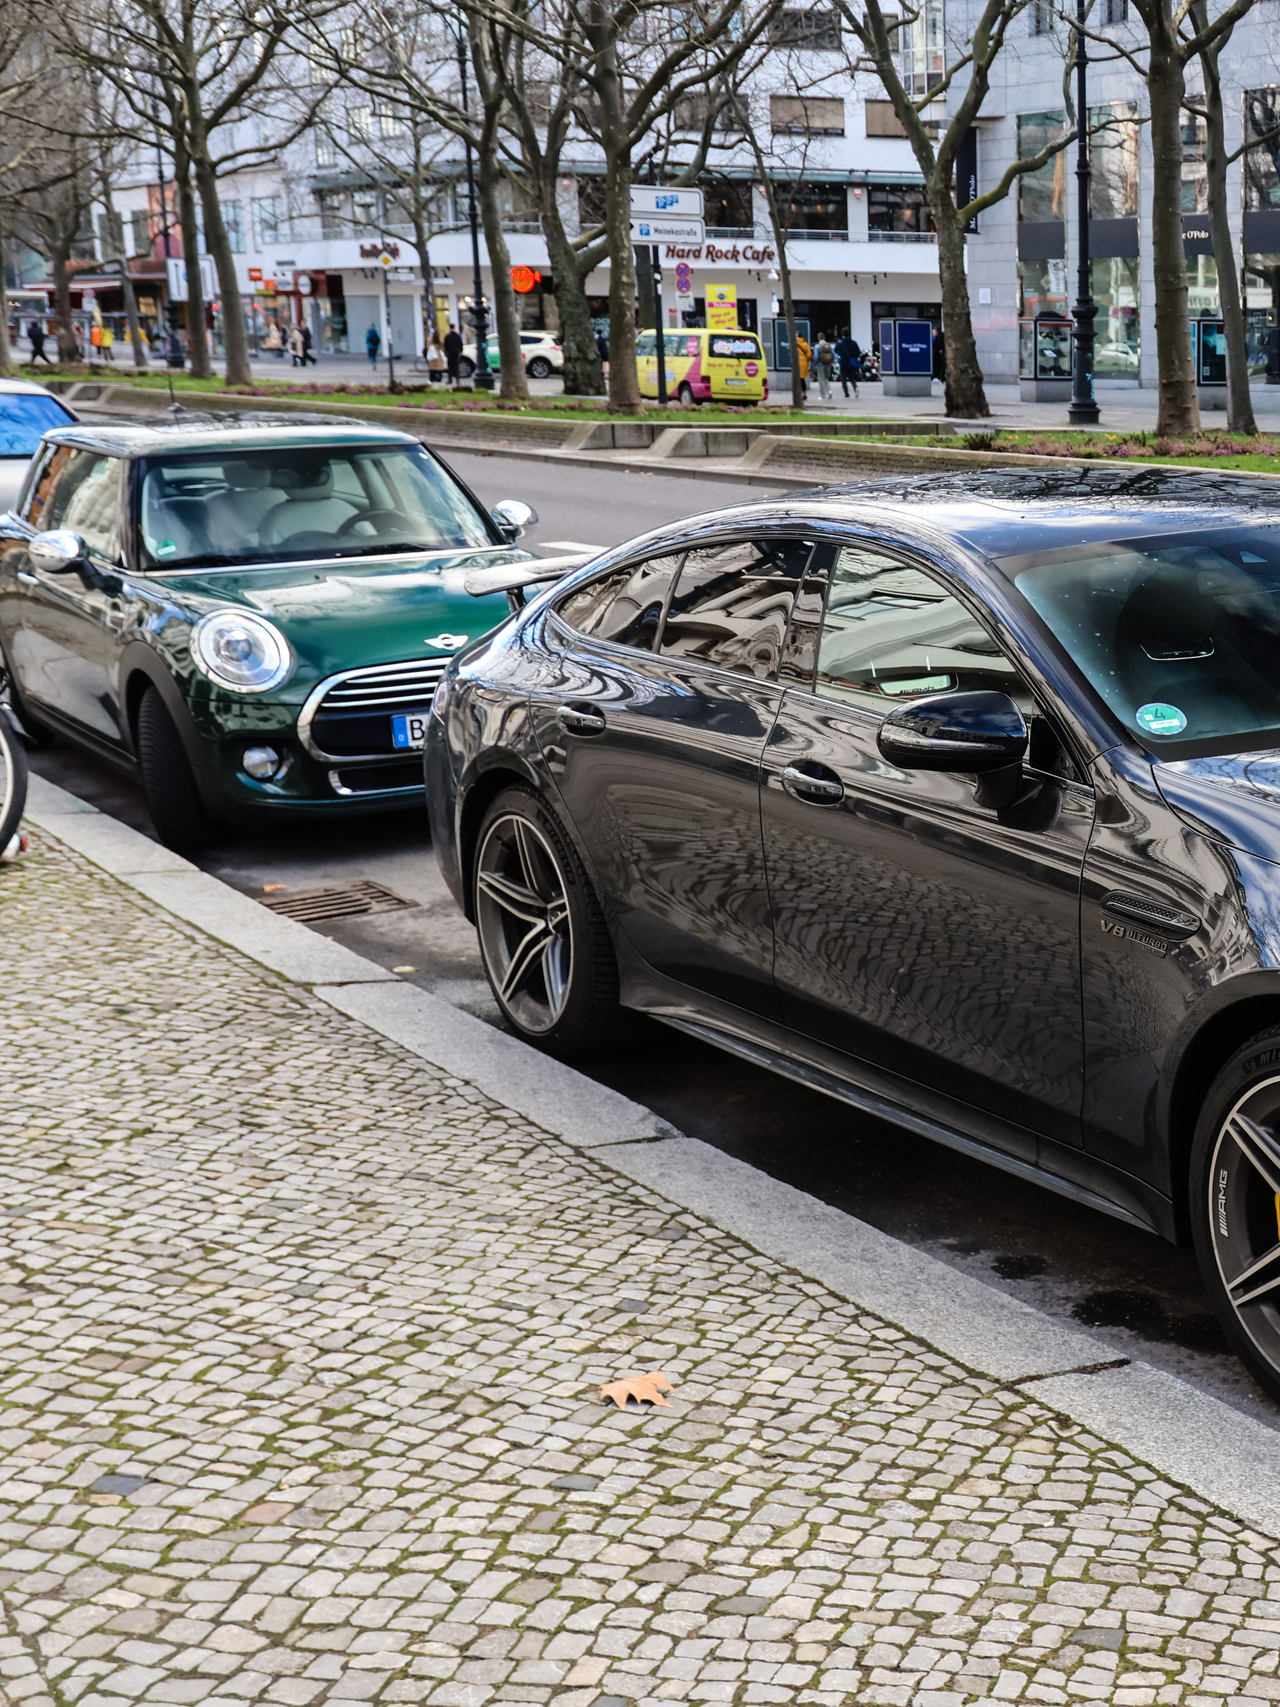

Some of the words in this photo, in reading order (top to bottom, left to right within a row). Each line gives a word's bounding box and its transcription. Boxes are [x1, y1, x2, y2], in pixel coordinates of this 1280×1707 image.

[653, 225, 698, 237] Meinekestraße
[1186, 230, 1209, 240] O'Polo
[665, 243, 701, 259] Hard
[705, 244, 740, 262] Rock
[742, 245, 775, 264] Cafe
[1154, 707, 1167, 720] 4
[409, 718, 425, 741] B
[1100, 919, 1125, 938] V8
[1126, 930, 1168, 951] BITURBO
